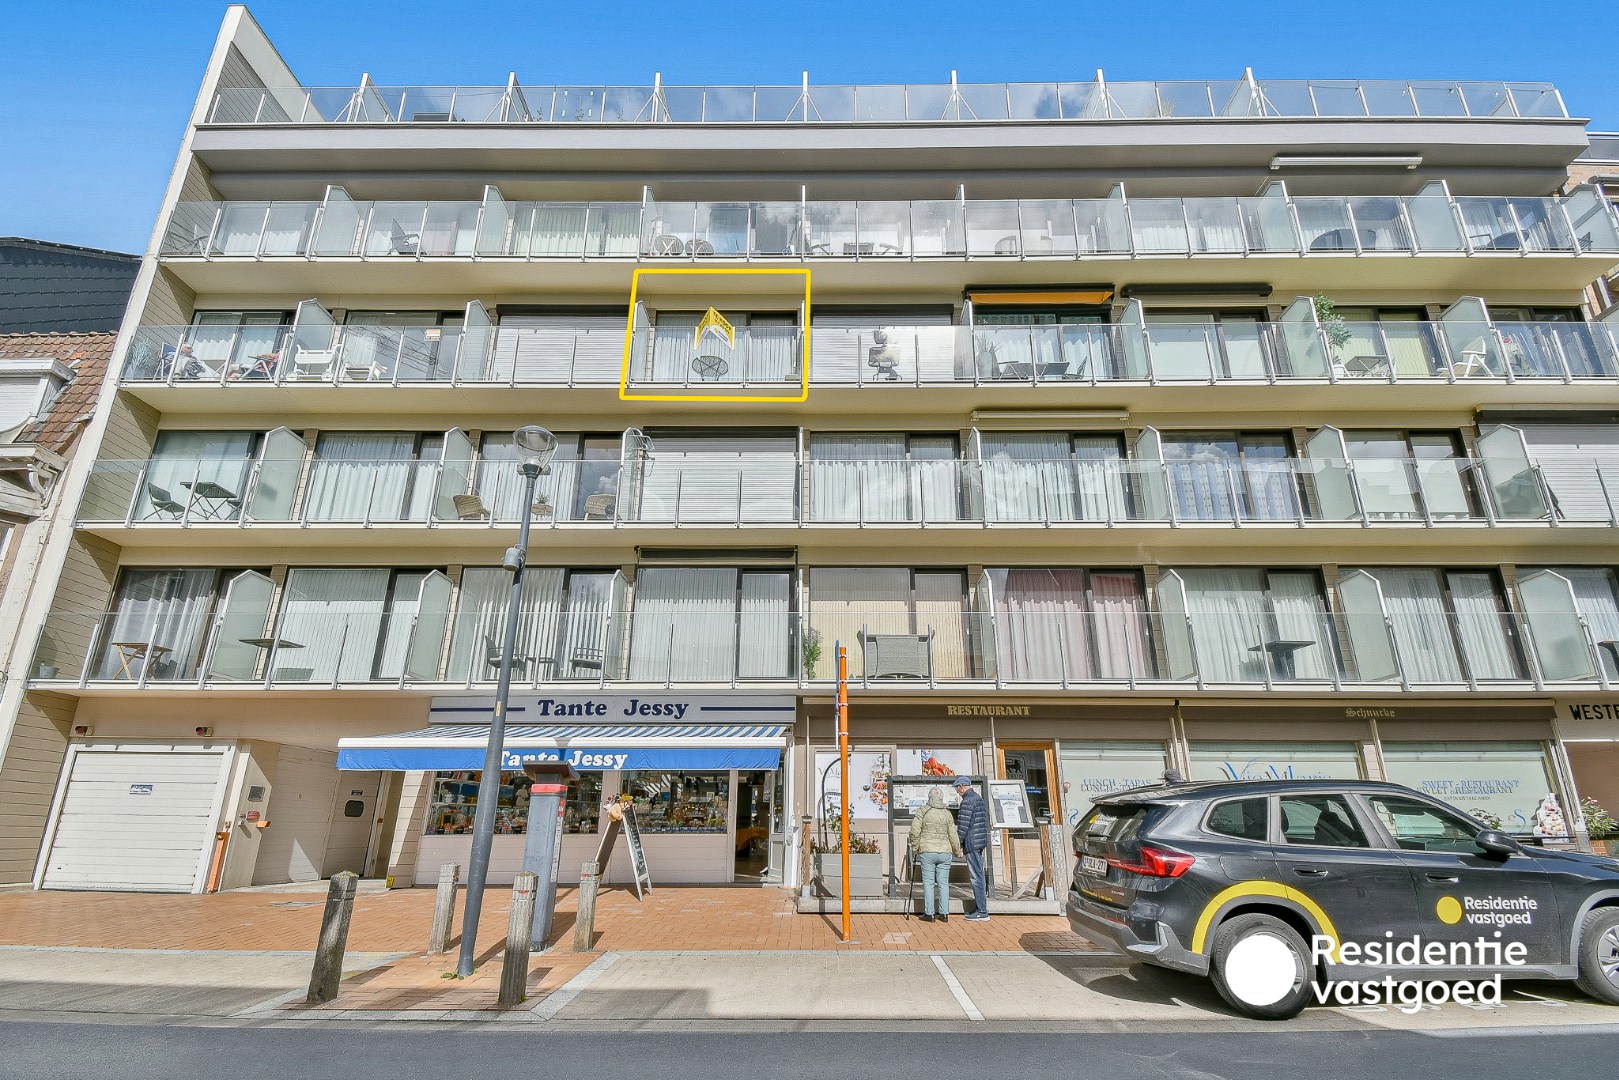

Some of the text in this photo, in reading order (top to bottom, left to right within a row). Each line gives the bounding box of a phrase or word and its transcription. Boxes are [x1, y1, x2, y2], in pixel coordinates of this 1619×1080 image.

[537, 699, 690, 720] Tante Jessy
[947, 705, 1031, 716] RESTAURANT
[567, 751, 629, 770] Jessy
[1464, 895, 1538, 911] Residentie
[1466, 911, 1532, 928] vastgoed
